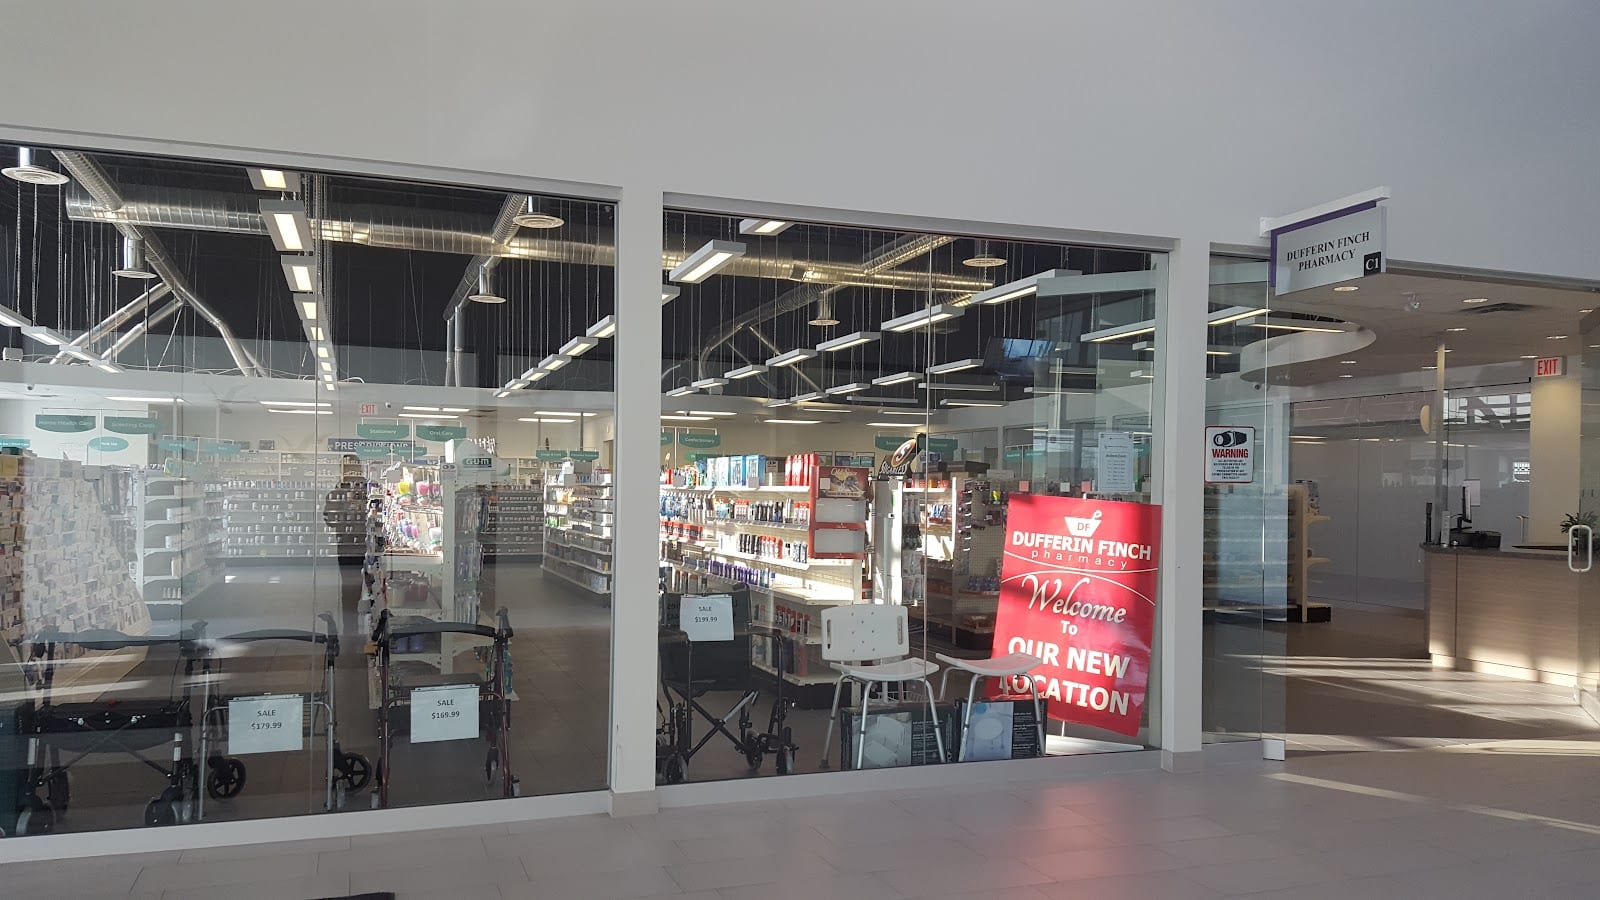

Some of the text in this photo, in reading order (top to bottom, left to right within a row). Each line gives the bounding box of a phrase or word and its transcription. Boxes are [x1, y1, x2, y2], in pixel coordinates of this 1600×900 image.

[1287, 231, 1370, 262] DUFFERIN FINCH
[1298, 248, 1356, 272] PHARMACY
[1365, 257, 1380, 271] C1
[1537, 358, 1558, 376] EXIT
[361, 404, 376, 414] EXIT
[1211, 448, 1249, 459] WARNING
[1077, 522, 1091, 532] DF
[1012, 530, 1152, 560] DUFFERIN FINCH
[1031, 549, 1127, 570] pharmacy
[1021, 574, 1127, 623] Welcome
[1060, 620, 1078, 636] To
[1008, 636, 1131, 679] OUR NEW
[436, 699, 454, 707] SALE
[257, 709, 277, 717] SALE
[431, 711, 460, 720] $169.99
[251, 722, 282, 730] $179.99
